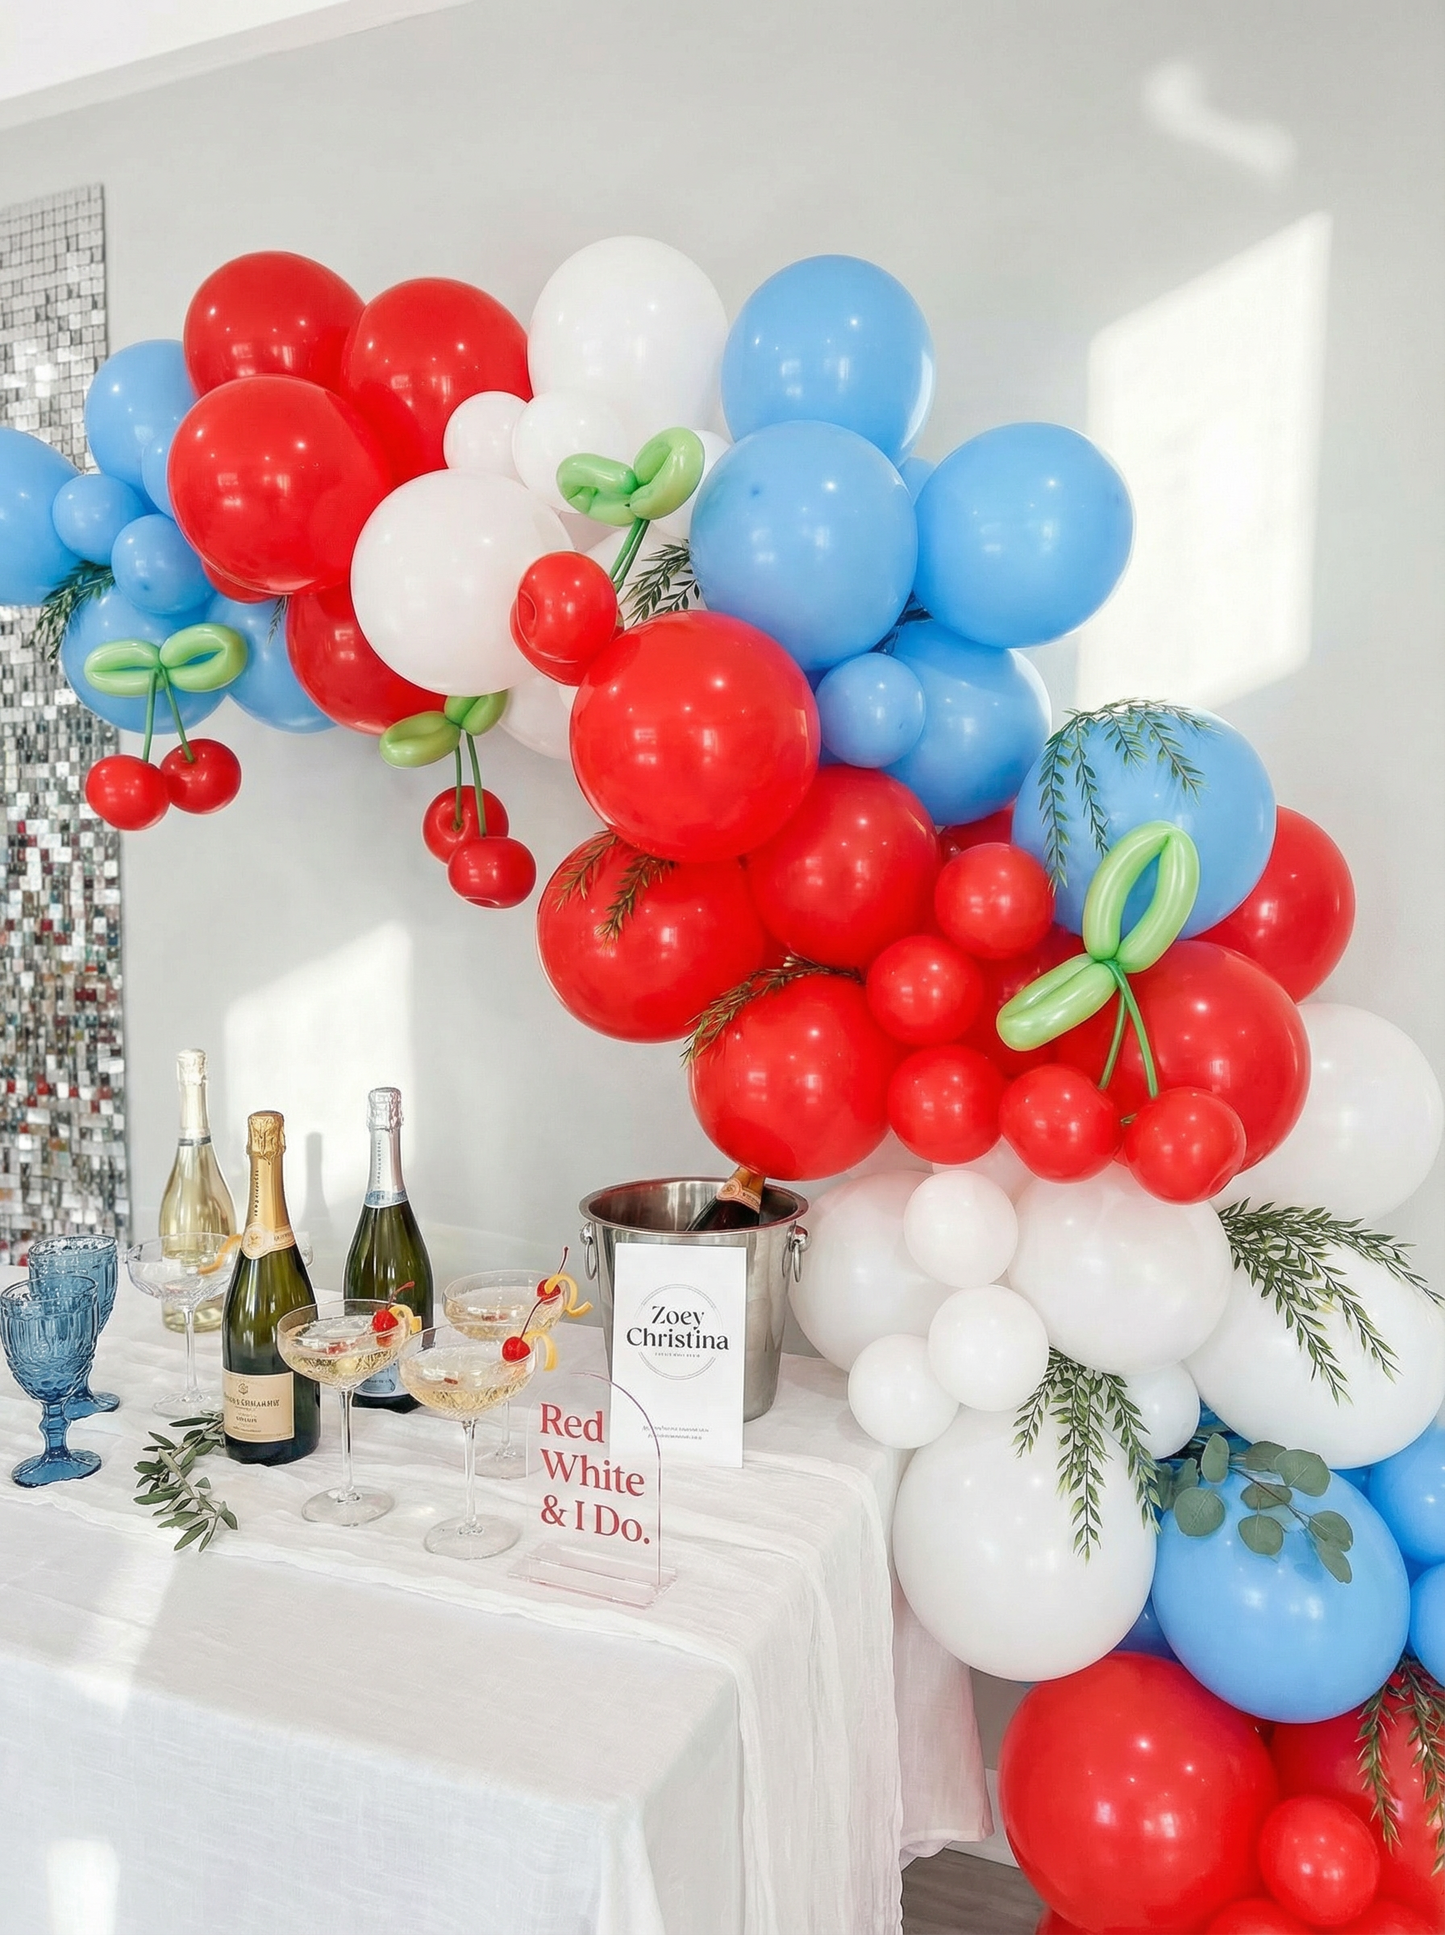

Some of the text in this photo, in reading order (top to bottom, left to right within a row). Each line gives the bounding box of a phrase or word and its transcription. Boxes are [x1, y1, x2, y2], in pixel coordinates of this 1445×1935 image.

[652, 1306, 704, 1330] Zoey
[626, 1327, 729, 1350] Christina
[541, 1403, 604, 1443] Red
[540, 1448, 645, 1497] White
[540, 1494, 650, 1544] & I Do.
